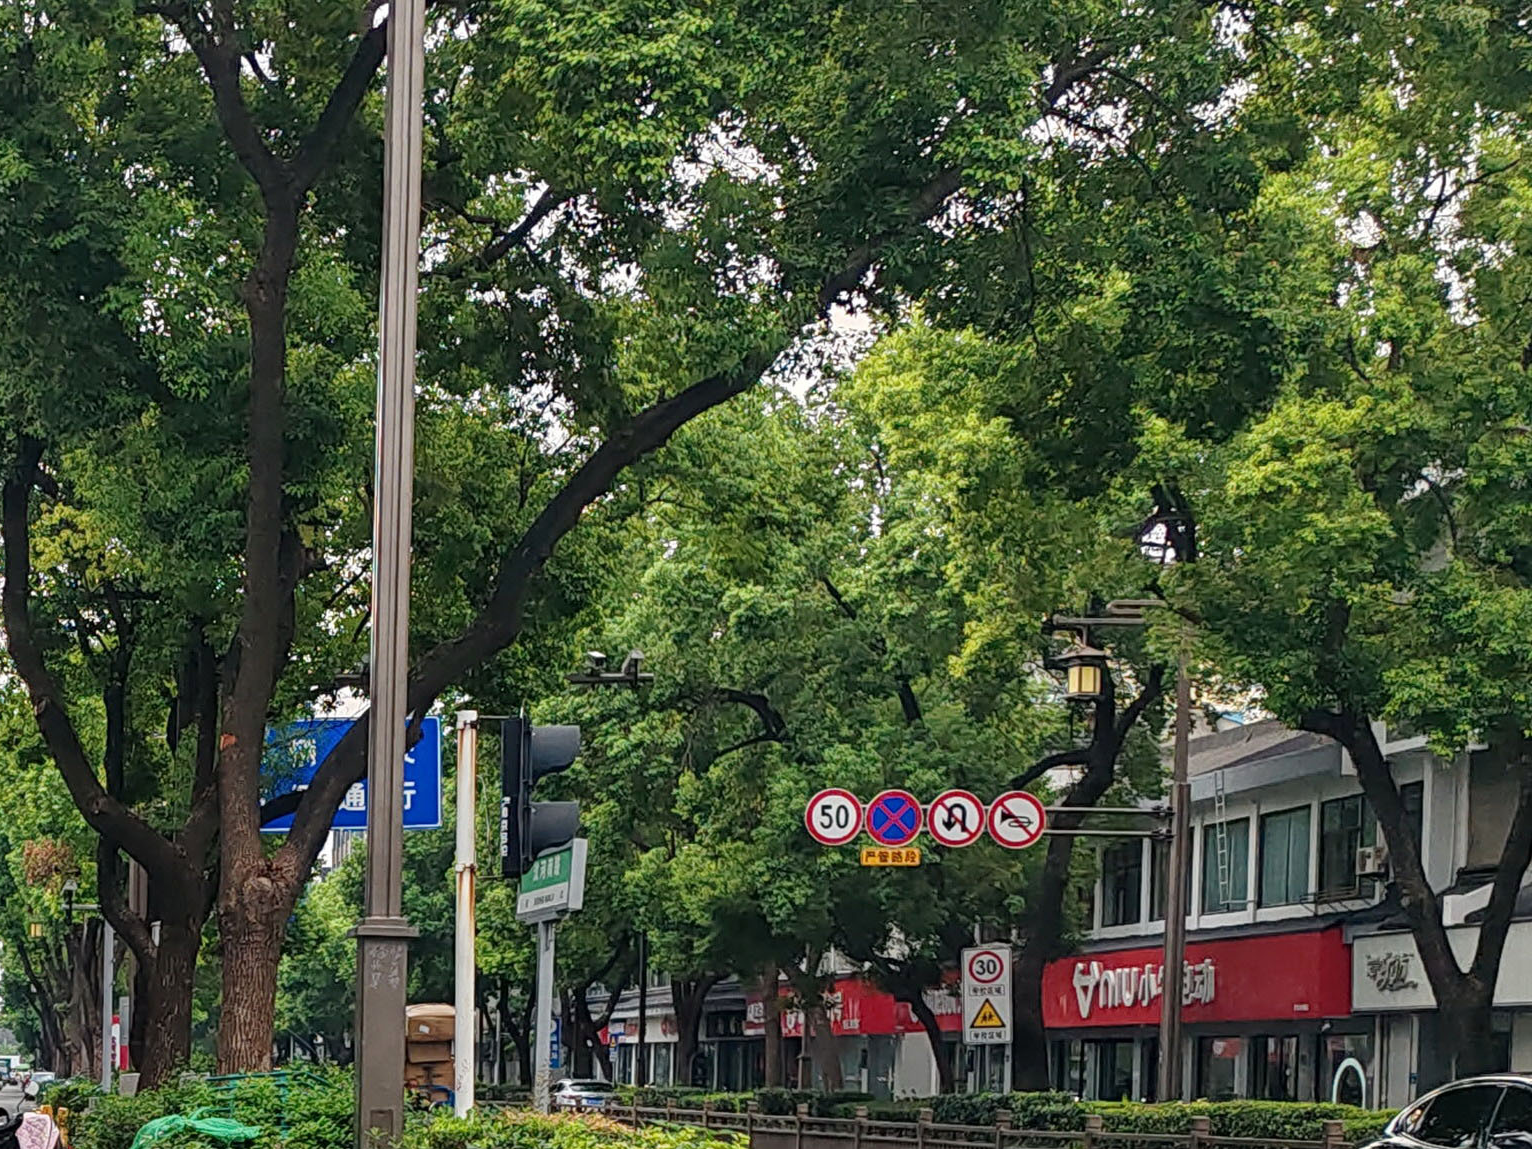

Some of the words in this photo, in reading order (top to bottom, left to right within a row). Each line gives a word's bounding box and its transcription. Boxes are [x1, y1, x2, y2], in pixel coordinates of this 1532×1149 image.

[820, 805, 849, 829] 50
[866, 851, 916, 863] 严管路段
[976, 959, 997, 975] 30
[1138, 958, 1215, 1008] 小电动
